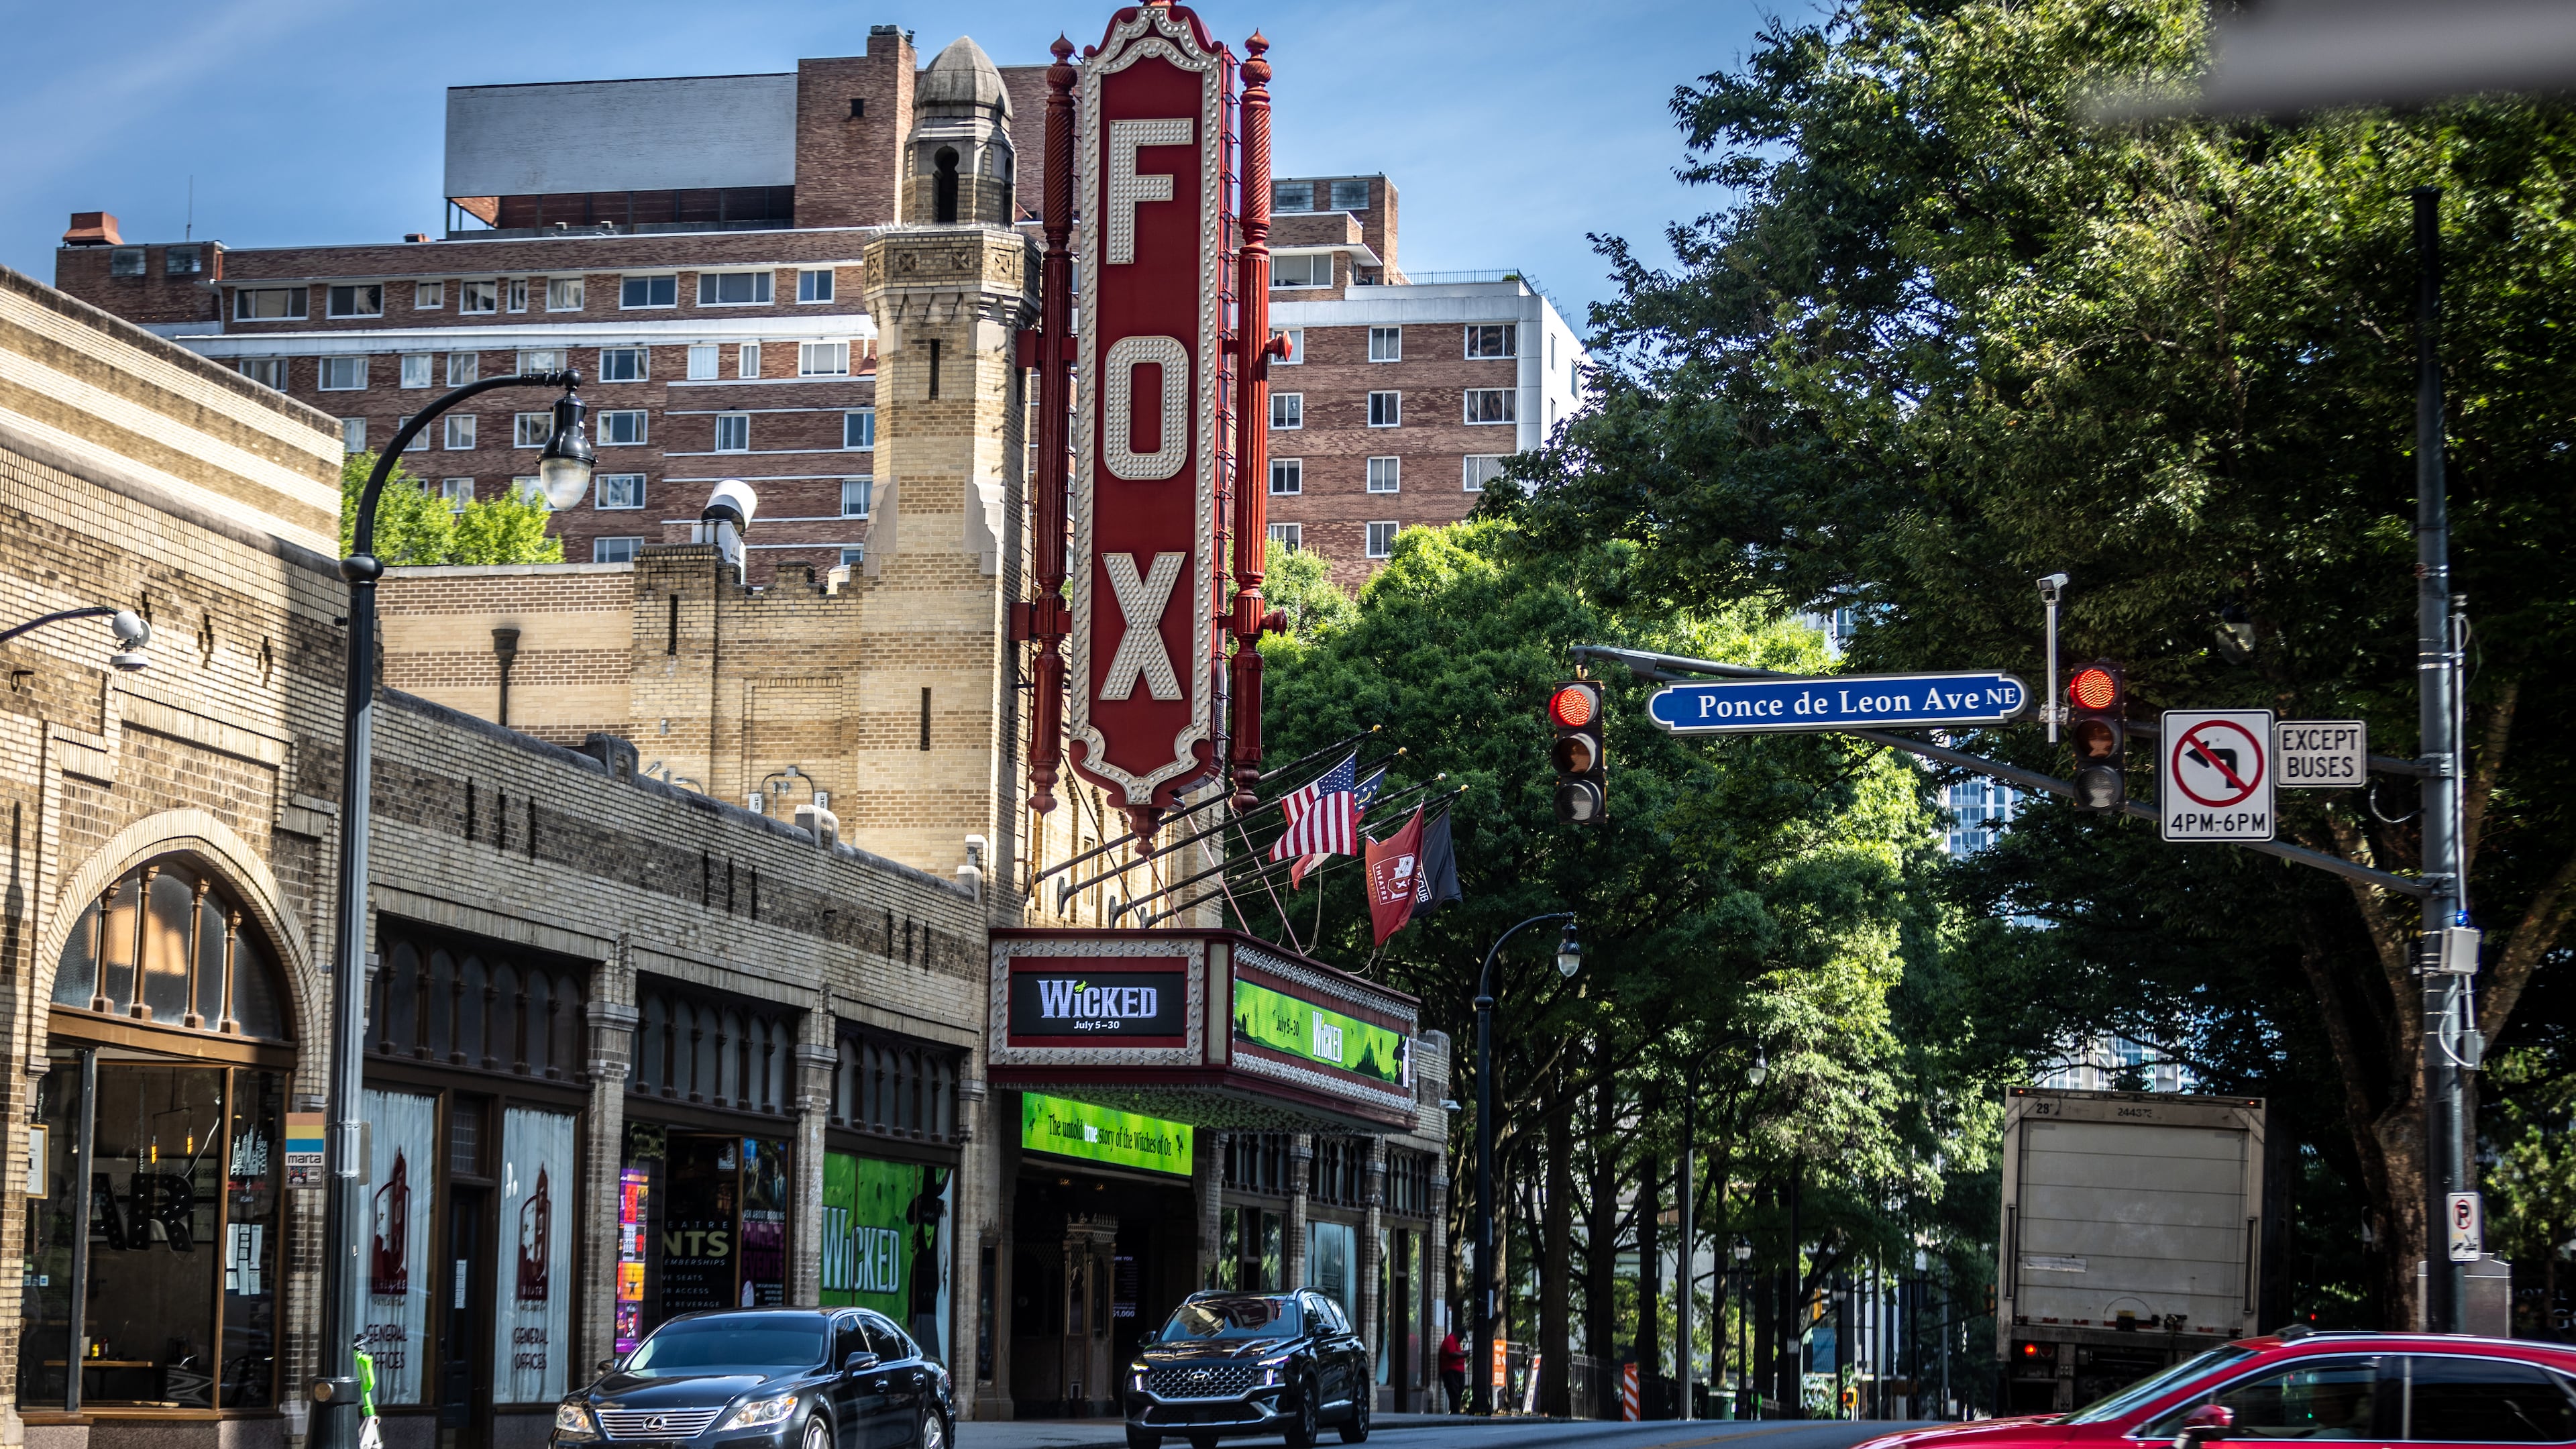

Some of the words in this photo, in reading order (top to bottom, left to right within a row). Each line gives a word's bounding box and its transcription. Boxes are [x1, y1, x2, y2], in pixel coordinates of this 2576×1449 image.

[1098, 118, 1193, 700] FOX
[1698, 695, 1783, 718] Ponce
[1794, 690, 1829, 715] de
[1838, 690, 1912, 713] Leon
[1922, 687, 1980, 710] Ave
[1986, 688, 2017, 704] NE
[2282, 729, 2358, 751] EXCEPT
[2288, 756, 2353, 777] BUSES
[2171, 813, 2265, 832] 4PM-6PM
[1375, 865, 1388, 901] THEATRE
[1074, 1021, 1093, 1031] July
[1277, 1015, 1286, 1037] July
[1049, 1114, 1061, 1136] The
[1063, 1118, 1083, 1140] untold
[1084, 1122, 1097, 1143] true
[1099, 1127, 1114, 1152] story
[1116, 1126, 1123, 1147] of
[1124, 1128, 1132, 1149] the
[1134, 1132, 1156, 1154] Witches
[1157, 1134, 1164, 1155] of
[1164, 1137, 1171, 1156] Oz
[288, 1154, 321, 1163] marta
[753, 1210, 767, 1220] ABOUT
[661, 1231, 729, 1257] NTS
[366, 1324, 408, 1343] GENERAL
[514, 1327, 548, 1344] GENERAL
[515, 1353, 547, 1370] OFFICES
